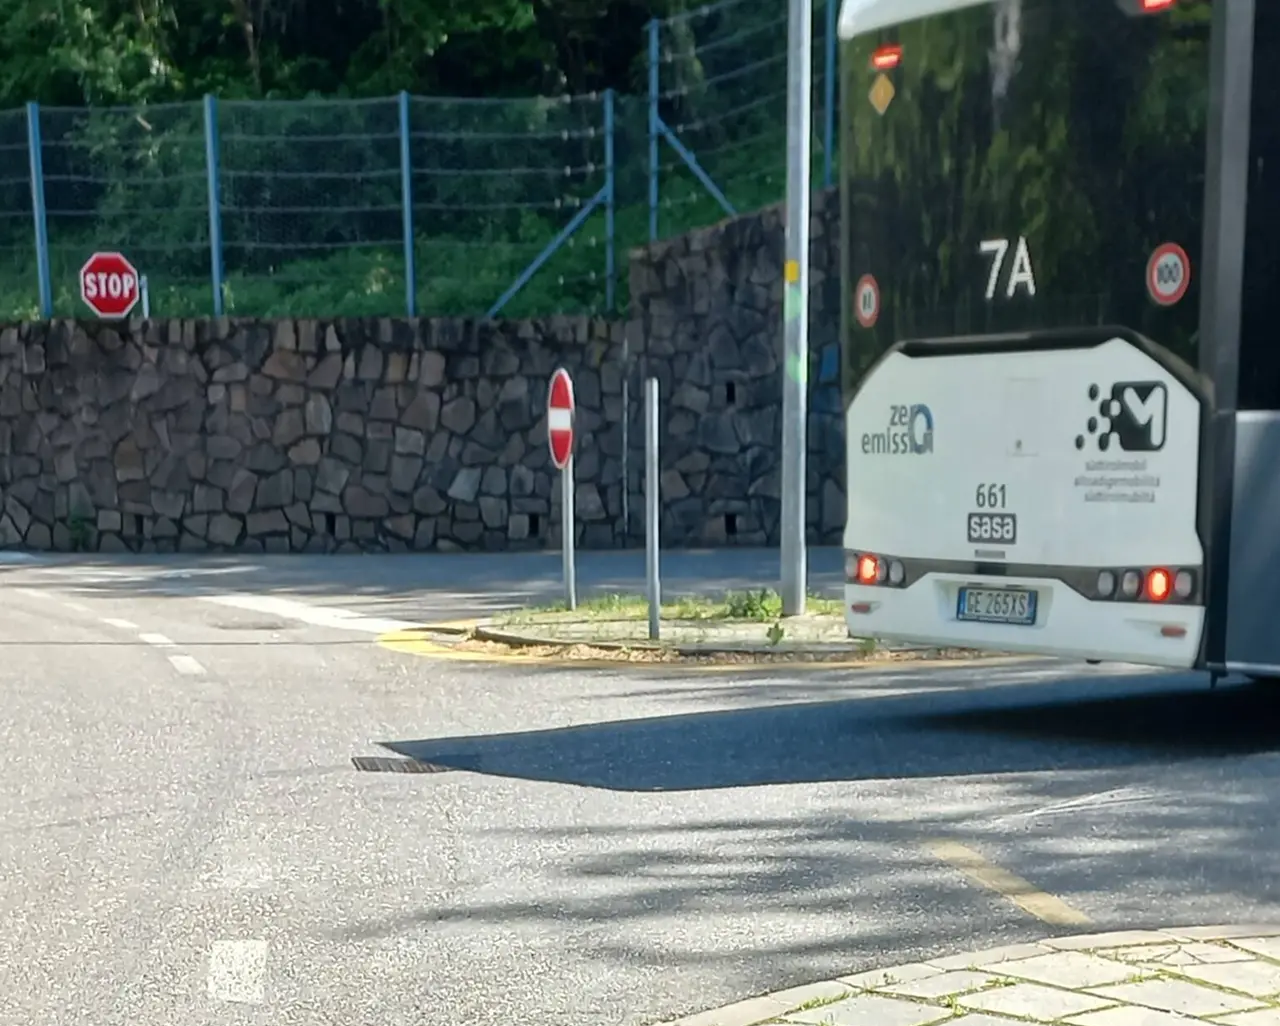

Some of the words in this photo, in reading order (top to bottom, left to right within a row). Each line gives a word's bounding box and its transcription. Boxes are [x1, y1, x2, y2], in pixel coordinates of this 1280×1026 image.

[980, 236, 1036, 299] 7A
[85, 271, 134, 298] STOP
[976, 483, 1007, 508] 661
[969, 516, 1014, 540] sasa
